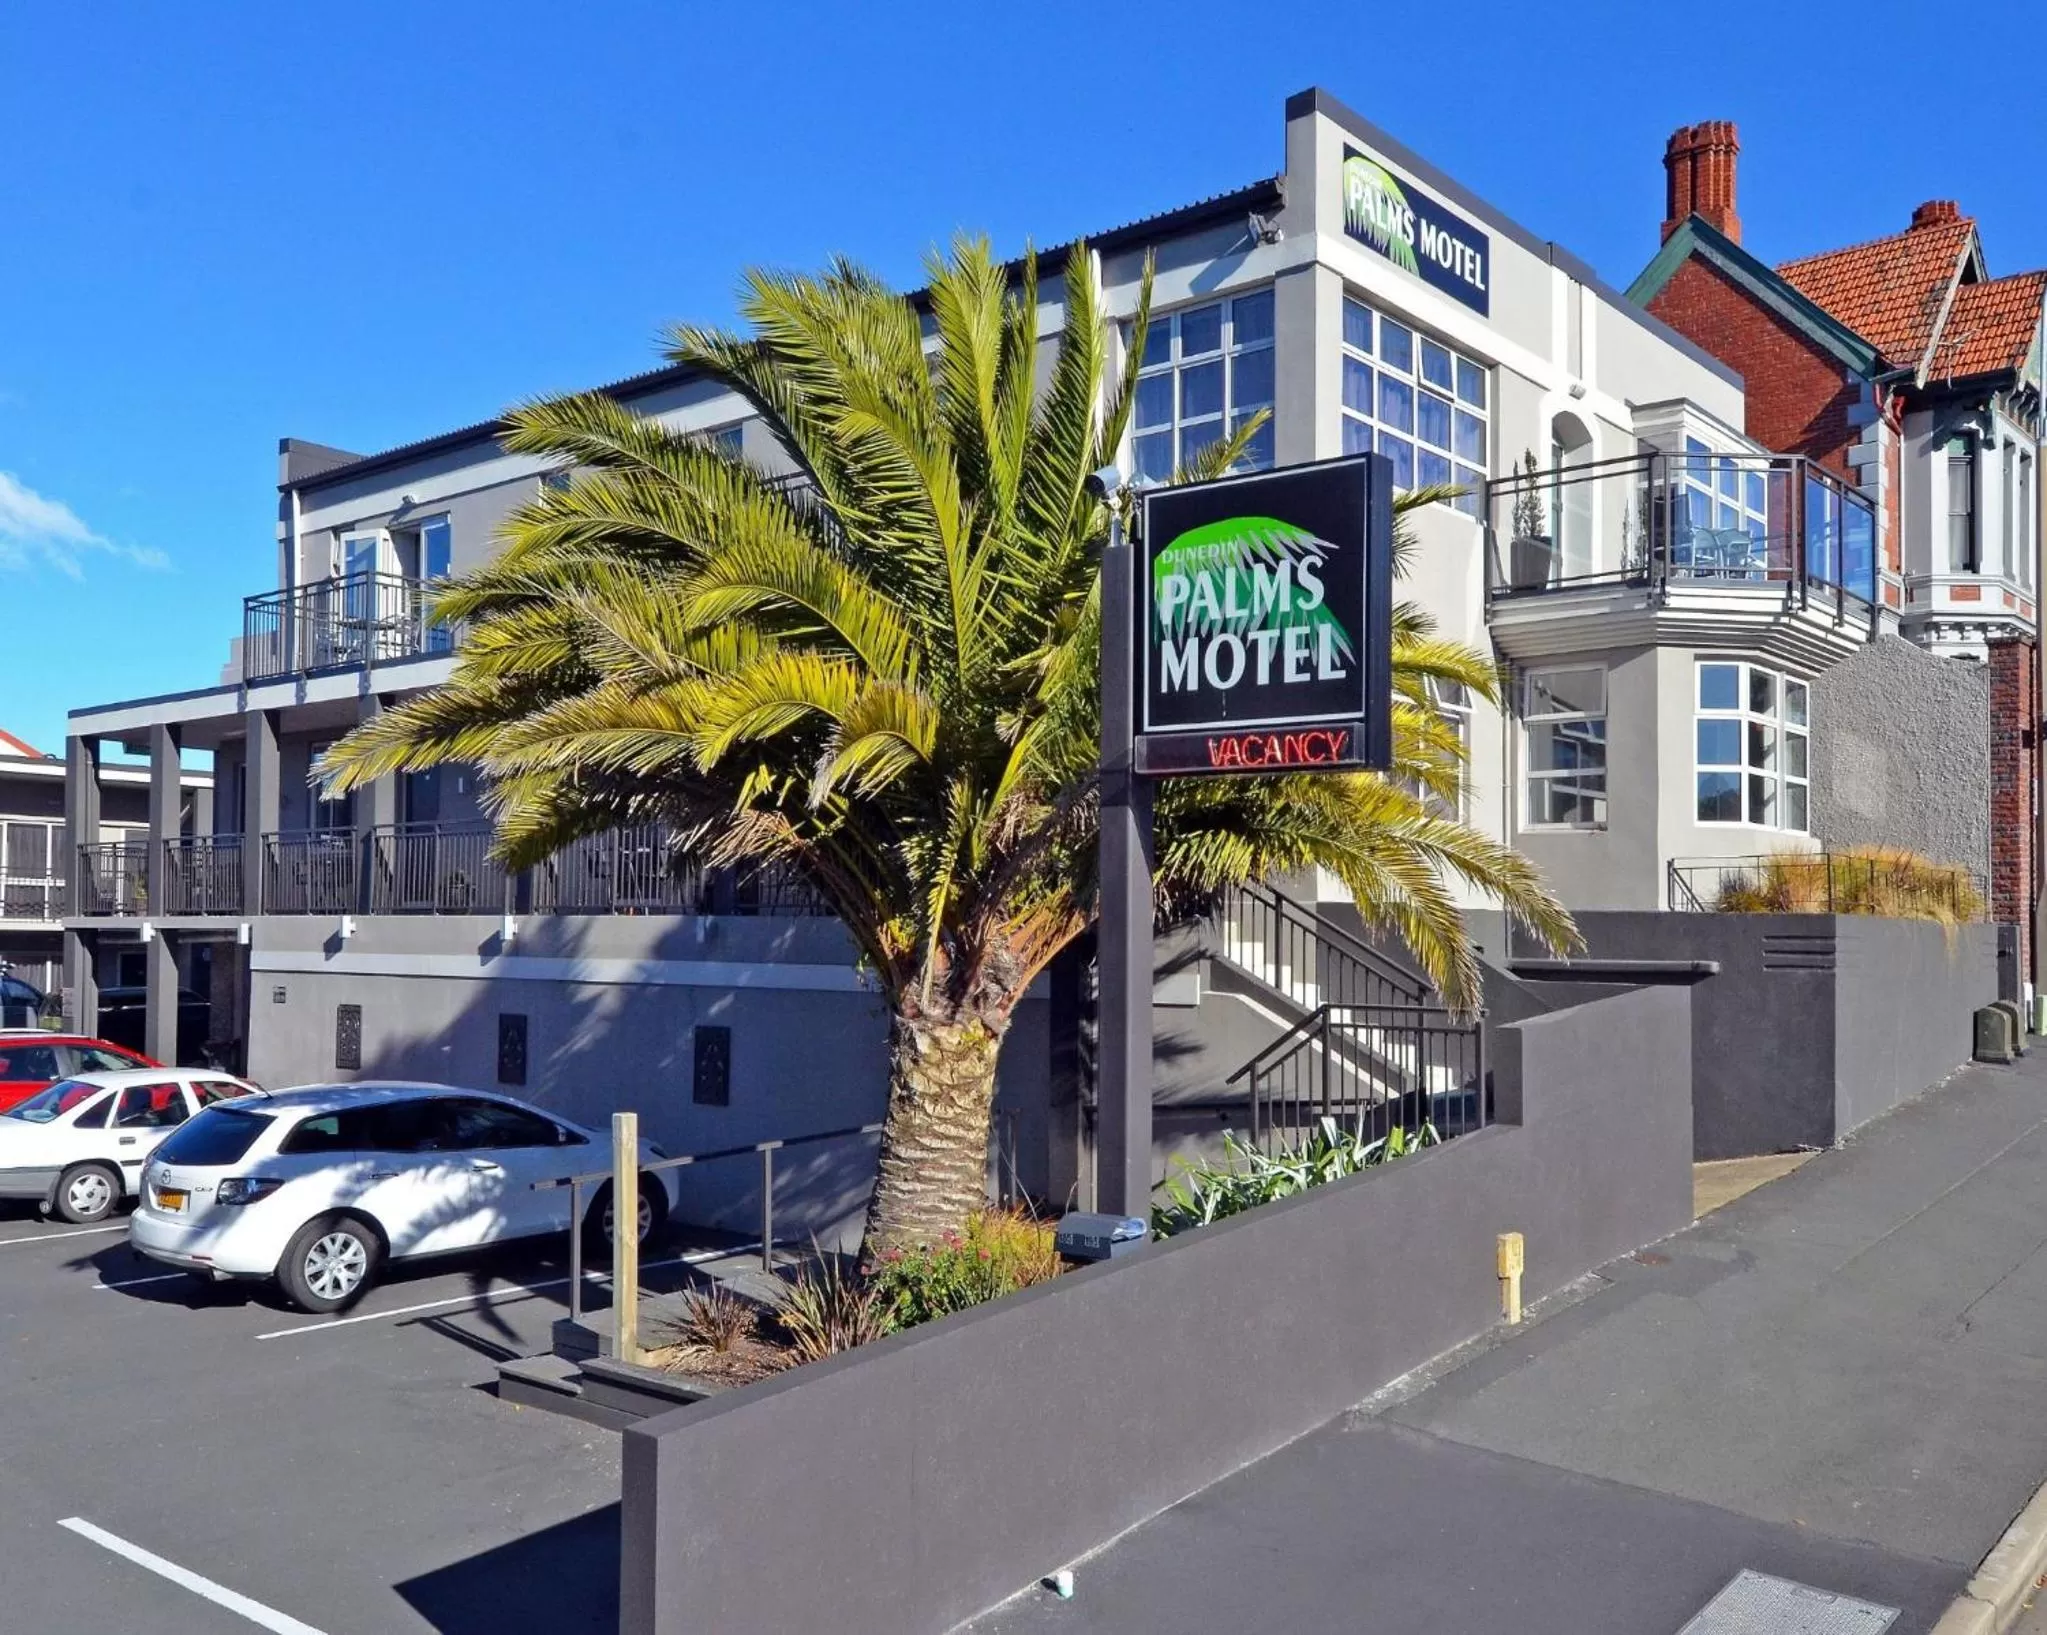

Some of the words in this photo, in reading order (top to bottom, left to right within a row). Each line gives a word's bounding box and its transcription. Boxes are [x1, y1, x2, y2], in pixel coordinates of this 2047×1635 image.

[1350, 177, 1415, 246] PALMS
[1420, 219, 1485, 290] MOTEL
[1162, 535, 1240, 564] DUNEDIN
[1159, 555, 1325, 625] PALMS
[1161, 623, 1346, 693] MOTEL
[1208, 731, 1347, 767] VACANCY
